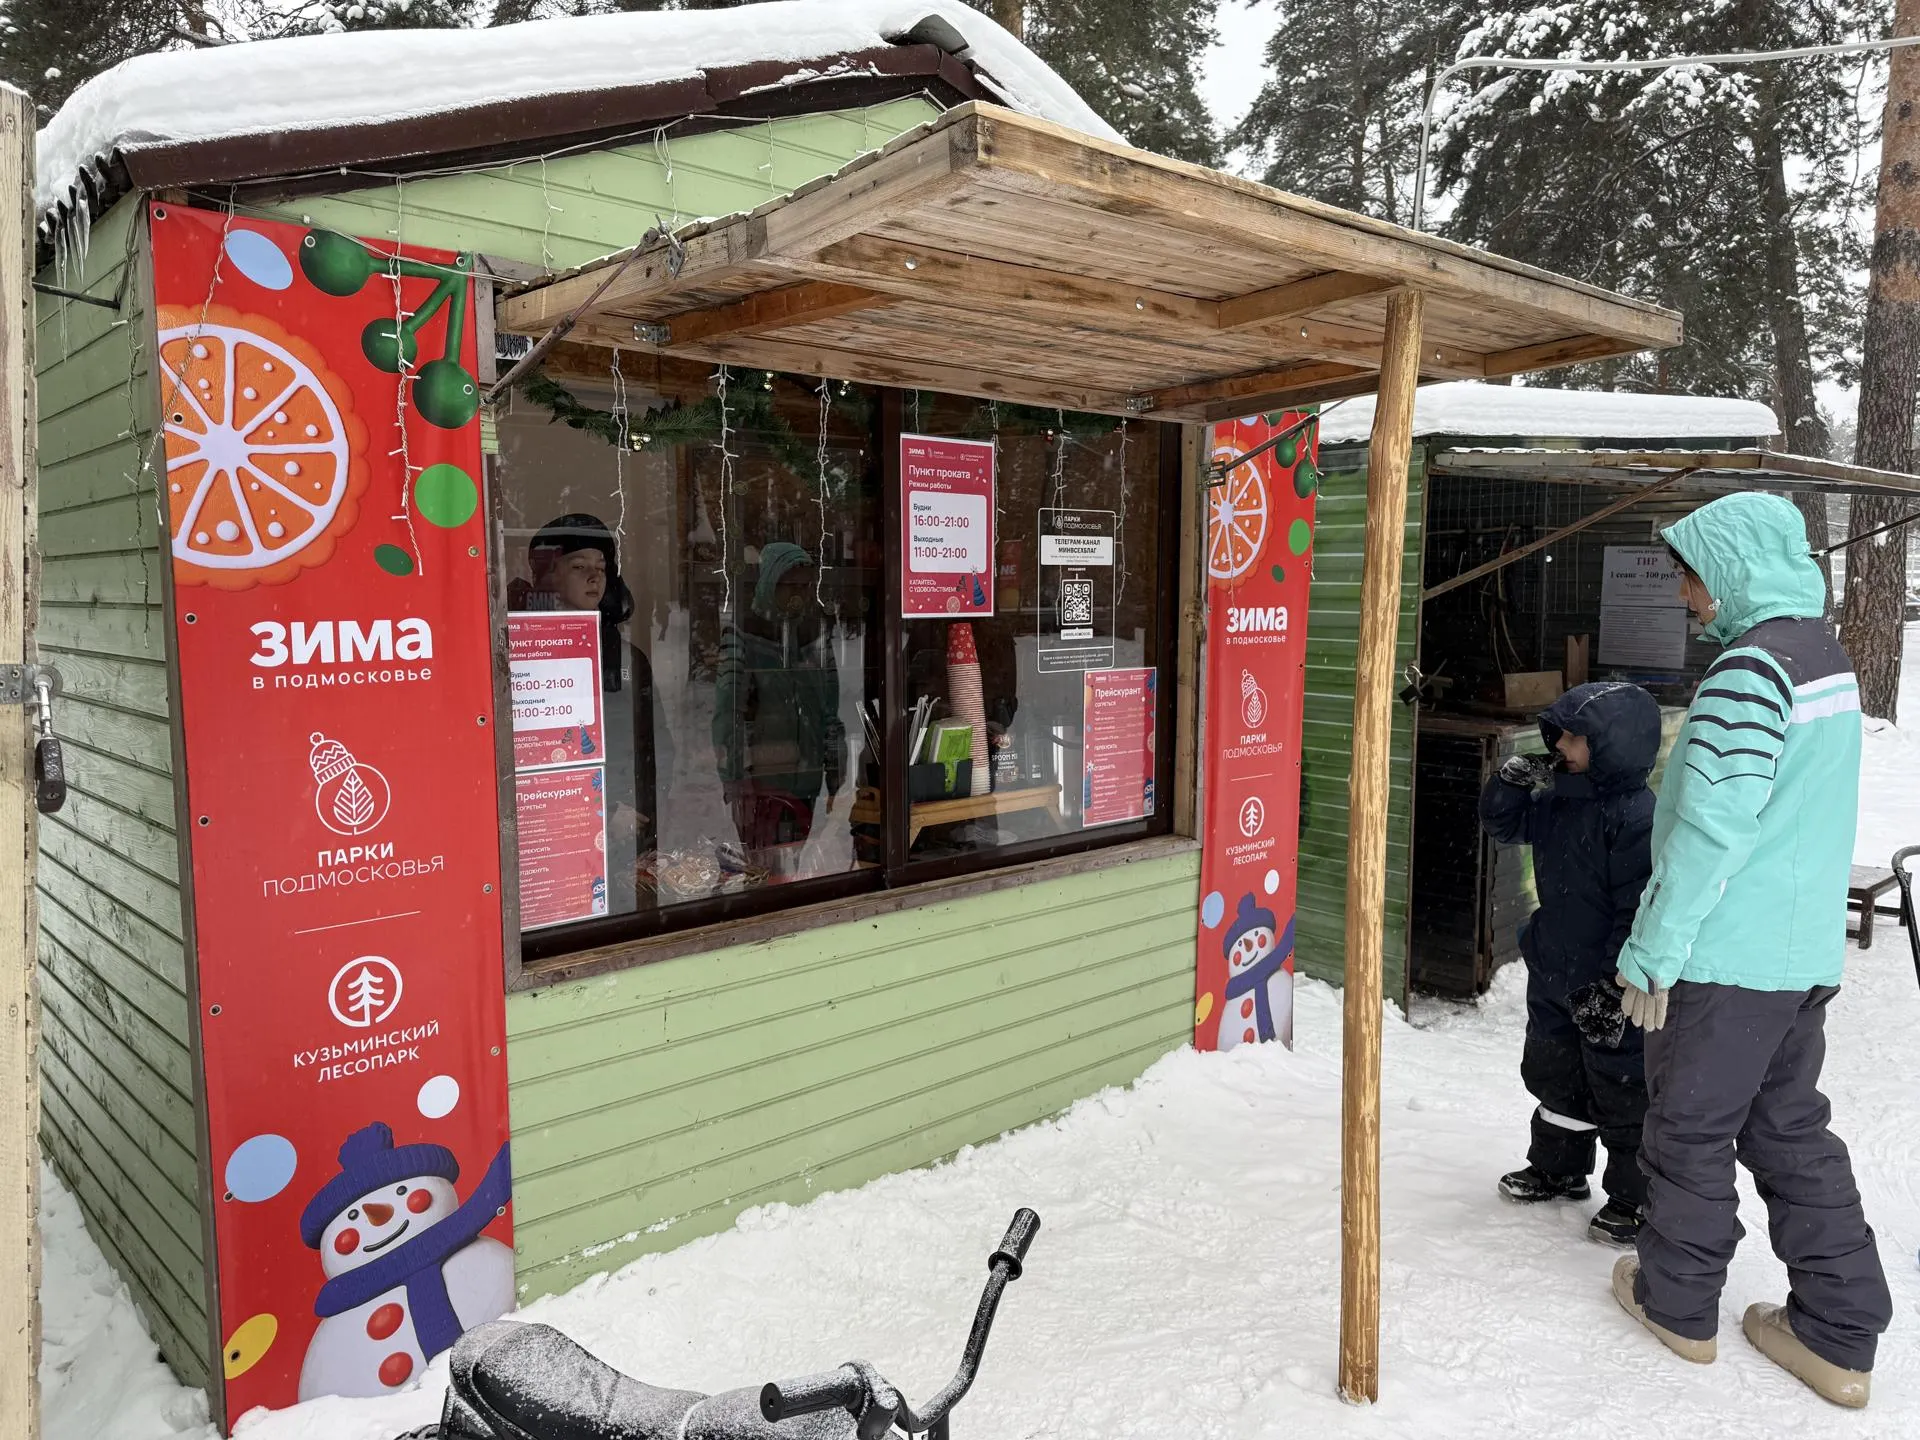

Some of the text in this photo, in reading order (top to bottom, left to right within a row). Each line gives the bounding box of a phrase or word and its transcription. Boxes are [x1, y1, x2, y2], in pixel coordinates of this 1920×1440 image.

[908, 465, 971, 480] Пункт проката
[908, 480, 952, 491] Режим работы
[913, 503, 932, 512] Будни
[913, 534, 944, 543] Выходные
[1055, 538, 1101, 546] ТЕЛЕГРАМ-КАНАЛ
[1636, 556, 1658, 566] ТИР
[1645, 571, 1659, 579] 100
[1226, 606, 1288, 633] зима
[249, 617, 433, 667] зима
[535, 638, 573, 648] проката
[527, 651, 552, 659] работы
[1095, 687, 1142, 700] Прейскурант
[1240, 733, 1267, 745] ПАРКИ
[1223, 742, 1283, 760] ПОДМОСКОВЬЯ
[515, 786, 583, 804] Прейскурант
[1226, 836, 1275, 856] КУЗЬМИНСКИЙ
[318, 842, 394, 868] ПАРКИ
[1232, 851, 1268, 866] ЛЕСОПАРК
[263, 855, 445, 898] ПОДМОСКОВЬЯ
[293, 1019, 440, 1068] КУЗЬМИНСКИЙ
[317, 1045, 420, 1083] ЛЕСОПАРК
